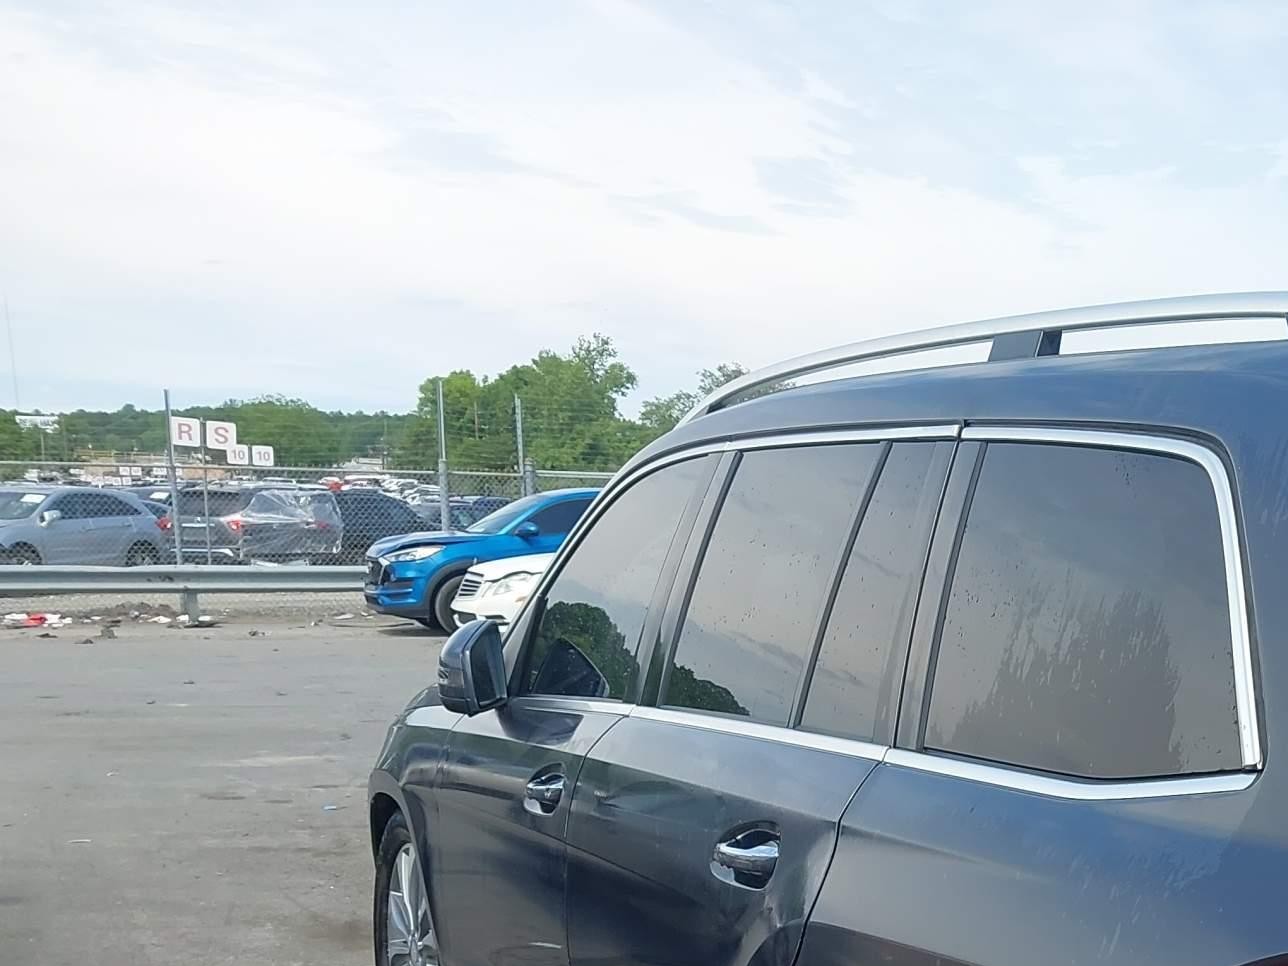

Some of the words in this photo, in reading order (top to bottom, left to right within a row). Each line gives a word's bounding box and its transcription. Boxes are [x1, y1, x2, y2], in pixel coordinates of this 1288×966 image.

[177, 422, 193, 441] R
[213, 426, 230, 445] S
[231, 448, 246, 461] 10
[256, 450, 271, 462] 10
